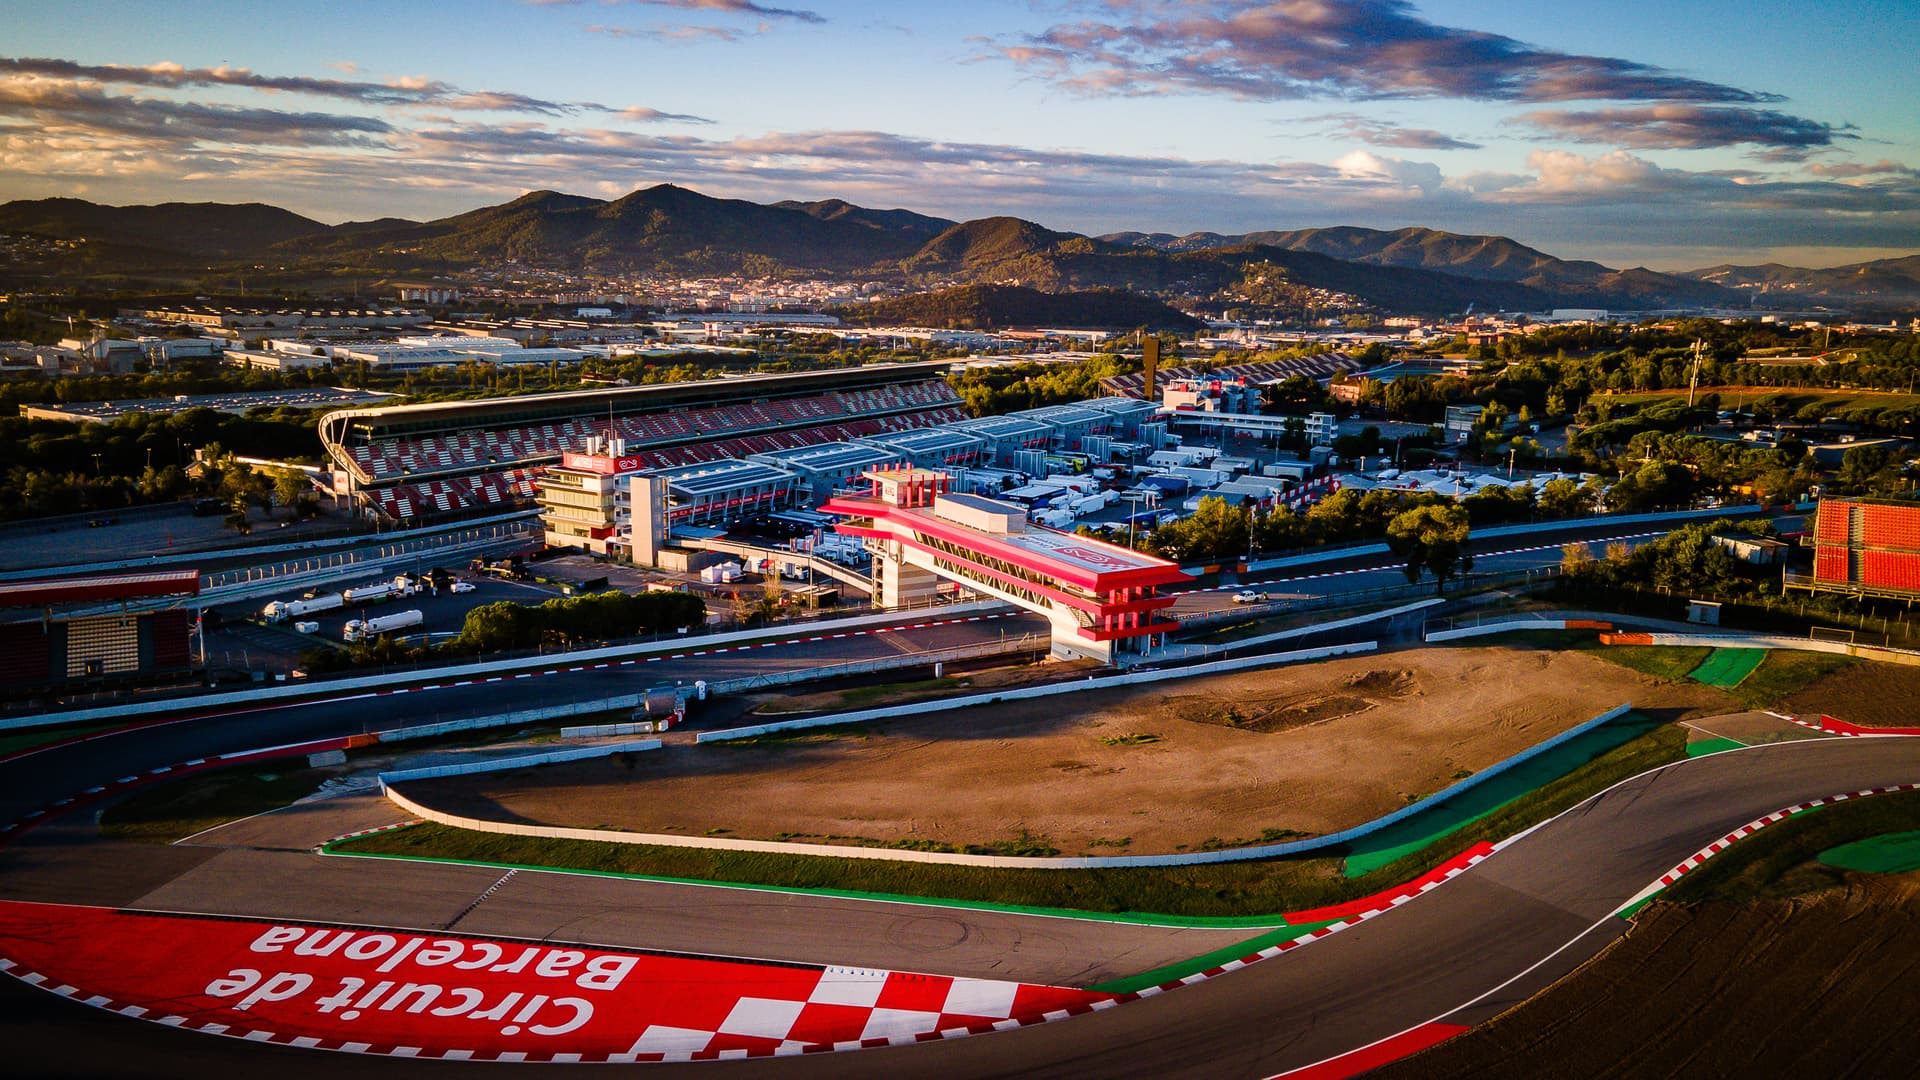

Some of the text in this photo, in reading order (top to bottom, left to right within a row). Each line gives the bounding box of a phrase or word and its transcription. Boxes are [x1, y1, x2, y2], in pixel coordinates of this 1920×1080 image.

[249, 926, 640, 991] Barcelona
[205, 968, 594, 1036] Circuit de
